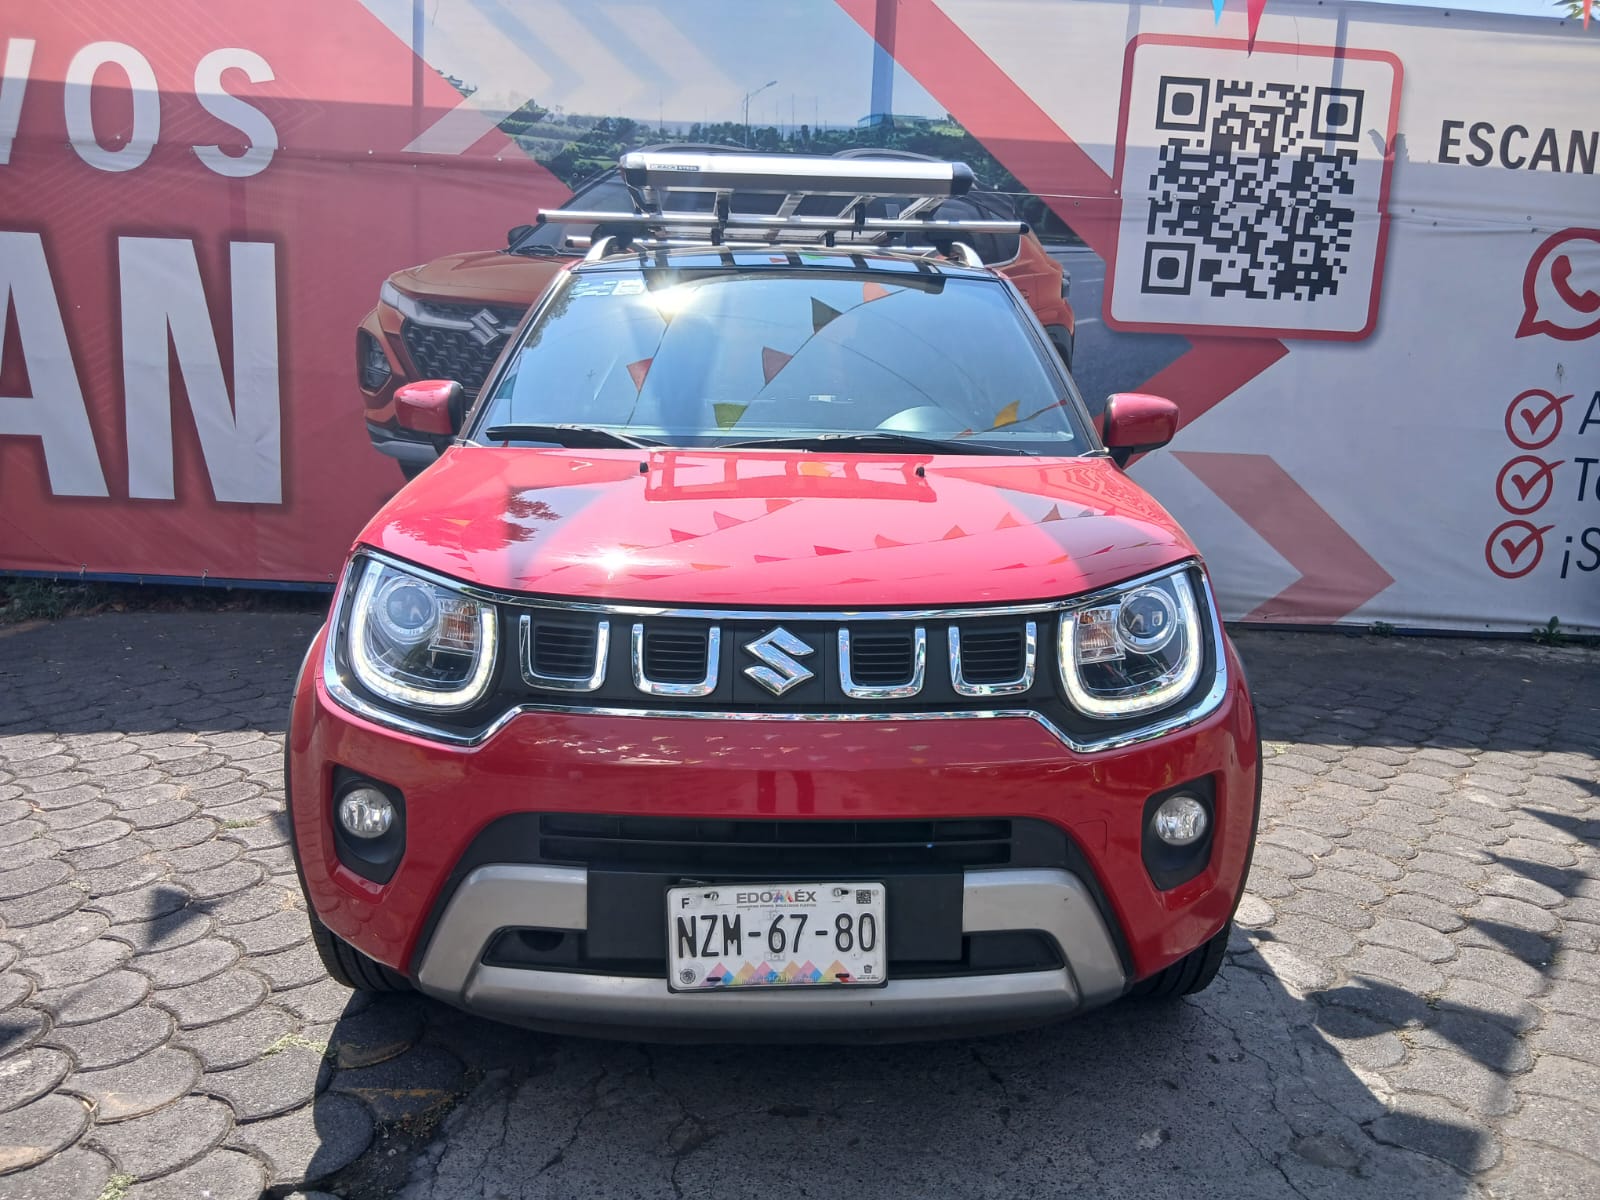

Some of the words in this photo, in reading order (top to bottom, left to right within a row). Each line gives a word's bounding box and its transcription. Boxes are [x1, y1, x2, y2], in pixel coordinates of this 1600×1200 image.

[1438, 119, 1600, 175] ESCAN
[681, 897, 690, 909] F
[677, 912, 876, 959] NZM-67-80
